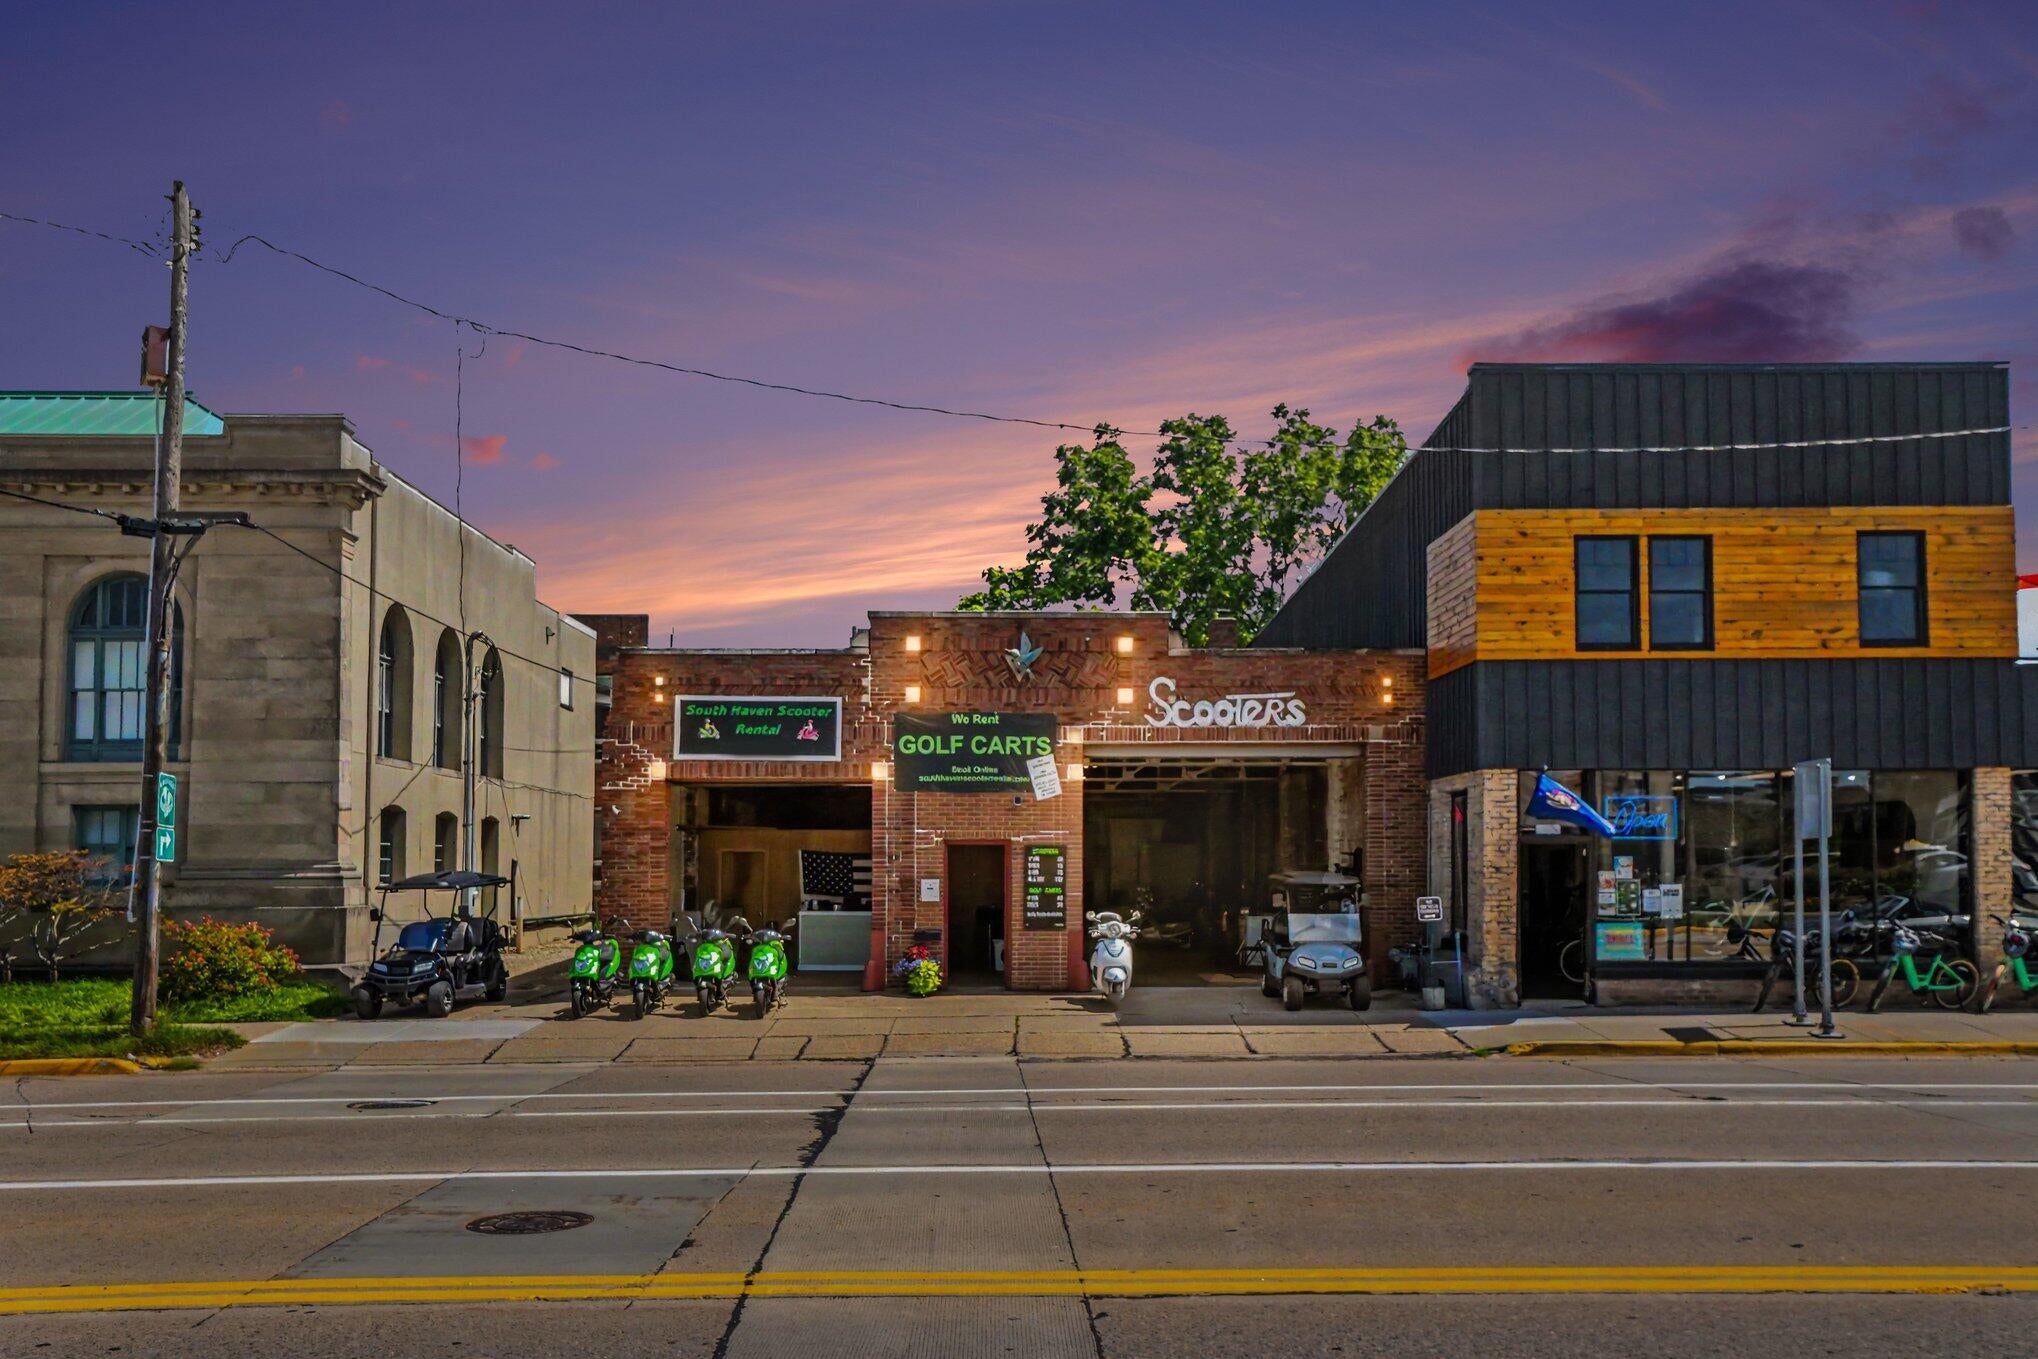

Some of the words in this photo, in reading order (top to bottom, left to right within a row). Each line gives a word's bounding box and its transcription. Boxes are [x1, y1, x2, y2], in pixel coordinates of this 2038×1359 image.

[685, 704, 727, 716] South
[731, 705, 773, 717] Haven
[777, 705, 833, 717] Scooter
[951, 713, 970, 725] We
[973, 713, 1000, 725] Rent
[735, 723, 782, 735] Rental
[898, 735, 964, 755] GOLF
[971, 735, 1052, 755] CARTS
[952, 765, 971, 774] Book
[974, 765, 998, 774] Online
[1614, 801, 1668, 835] Open
